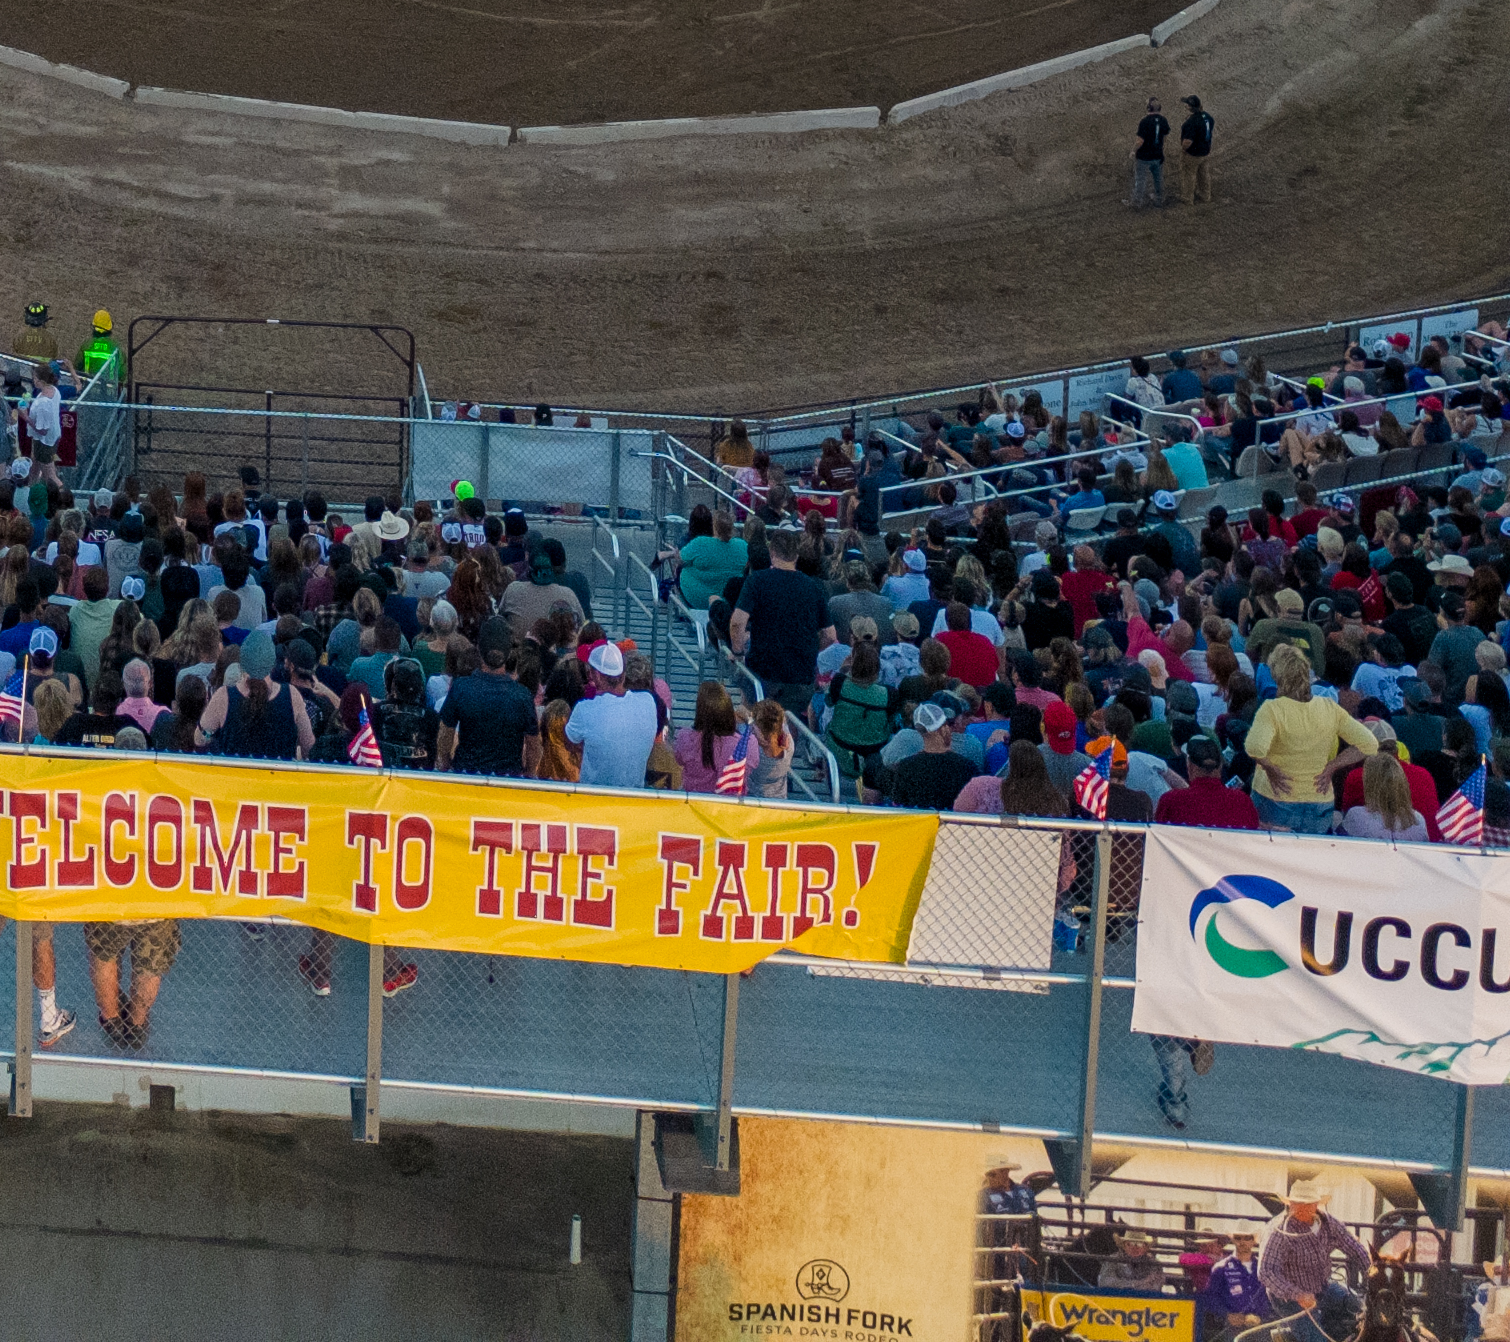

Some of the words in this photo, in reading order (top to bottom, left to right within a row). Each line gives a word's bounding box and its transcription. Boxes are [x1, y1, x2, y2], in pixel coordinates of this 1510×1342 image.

[1076, 375, 1104, 387] Richard
[345, 809, 434, 915] TO
[470, 817, 619, 932] THE
[654, 831, 880, 944] FAIR!
[728, 1303, 841, 1325] SPANISH
[846, 1308, 914, 1337] FORK
[740, 1324, 793, 1336] FIESTA
[799, 1326, 838, 1338] DAYS
[1059, 1302, 1180, 1338] Wrangler
